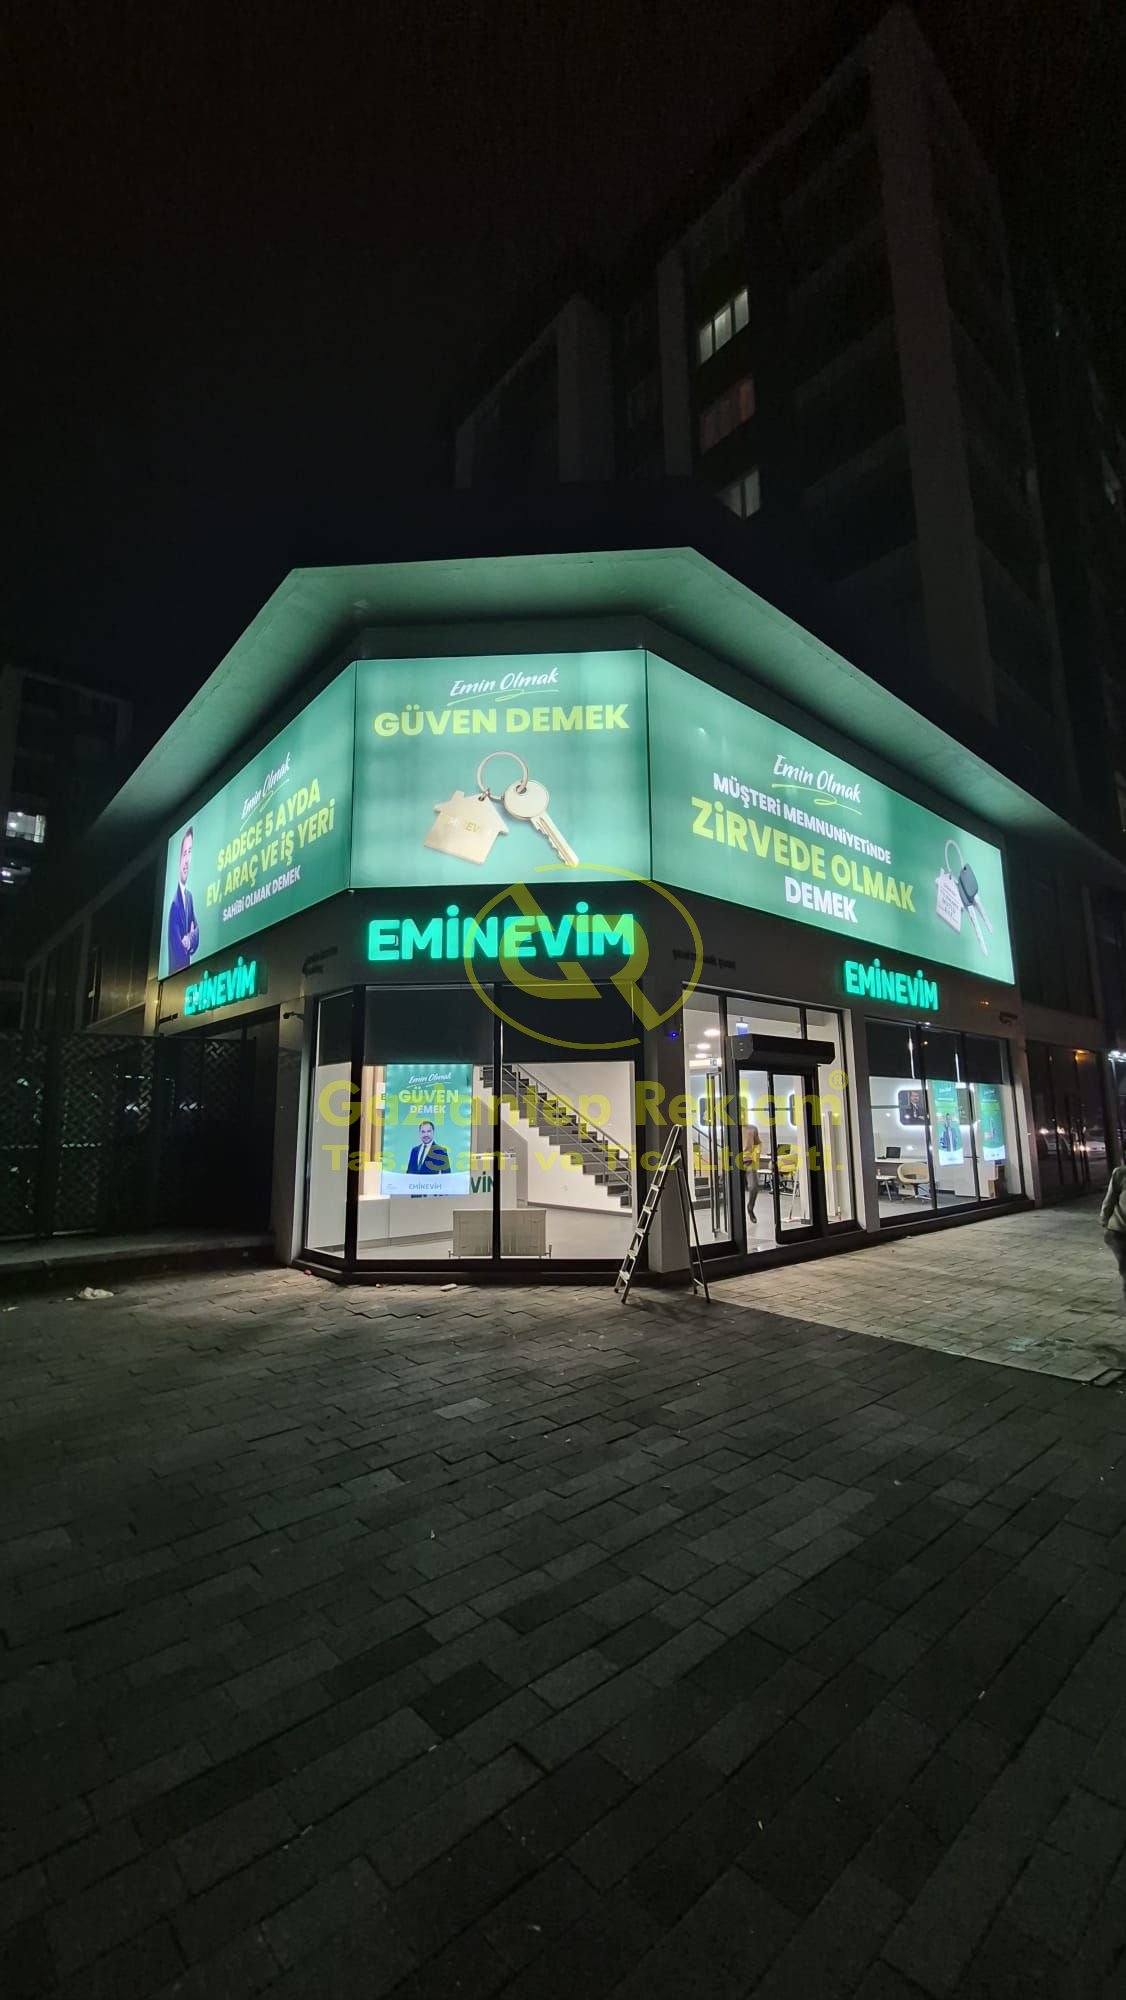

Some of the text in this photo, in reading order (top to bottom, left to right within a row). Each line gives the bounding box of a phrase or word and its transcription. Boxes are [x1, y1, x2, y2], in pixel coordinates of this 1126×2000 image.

[450, 667, 559, 697] Emin Olmak
[374, 703, 630, 737] GÜVEN DEMEK
[241, 752, 290, 820] Emin Olmak
[773, 754, 862, 803] Emin Olmak
[217, 777, 321, 872] SADECE 5 AYDA
[713, 772, 892, 865] MÜŞTERİ MEMNUNİYETİNDE
[205, 798, 336, 908] EV, ARAÇ VE İŞ YERİ
[691, 796, 826, 880] ZİRVEDE
[831, 854, 916, 913] OLMAK
[222, 864, 302, 922] SAHİBİ OLMAK DEMEK
[784, 875, 858, 924] DEMEK
[368, 901, 635, 961] EMİNEVİM
[185, 955, 257, 1016] EMİNEVİM
[844, 958, 939, 1011] EMİNEVİM
[398, 1086, 460, 1104] GÜVEN
[410, 1104, 446, 1114] DEMEK
